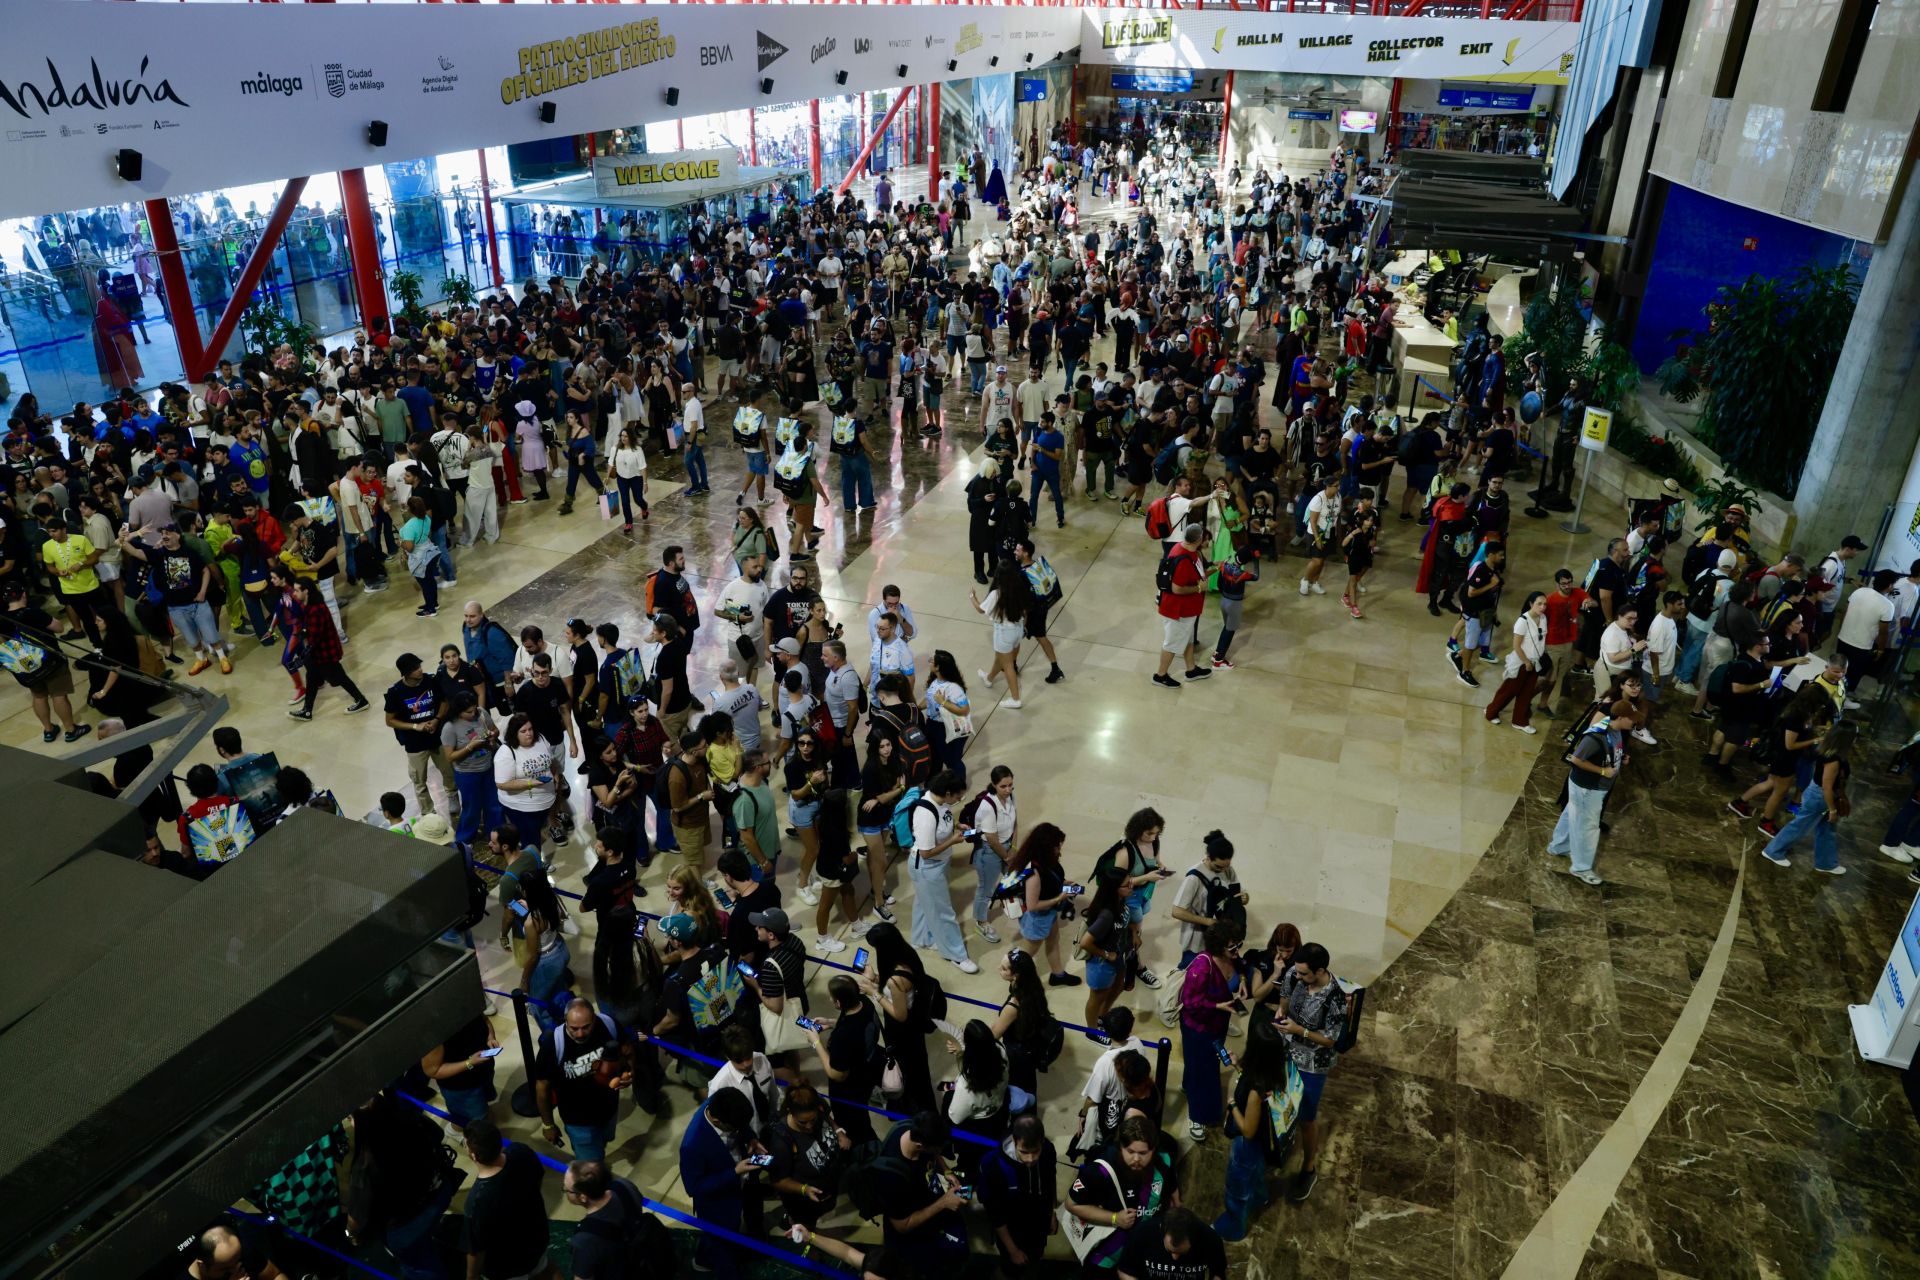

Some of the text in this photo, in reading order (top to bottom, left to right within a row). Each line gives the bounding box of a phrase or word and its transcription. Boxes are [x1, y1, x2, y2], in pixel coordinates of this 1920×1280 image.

[519, 16, 660, 74] PATROCINADORES
[1237, 32, 1283, 46] HALL M
[1299, 34, 1354, 48] VILLAGE
[1369, 36, 1444, 51] COLLECTOR
[700, 43, 733, 66] BBVA
[1460, 42, 1493, 55] EXIT
[1367, 50, 1400, 62] HALL
[347, 68, 372, 79] Ciudad
[500, 34, 677, 105] OFICIALES DEL EVENTO
[349, 79, 385, 92] de Málaga
[422, 74, 458, 86] Agencia Digital
[614, 160, 720, 186] WELCOME
[1145, 1260, 1208, 1273] SLEEP TOKEN
